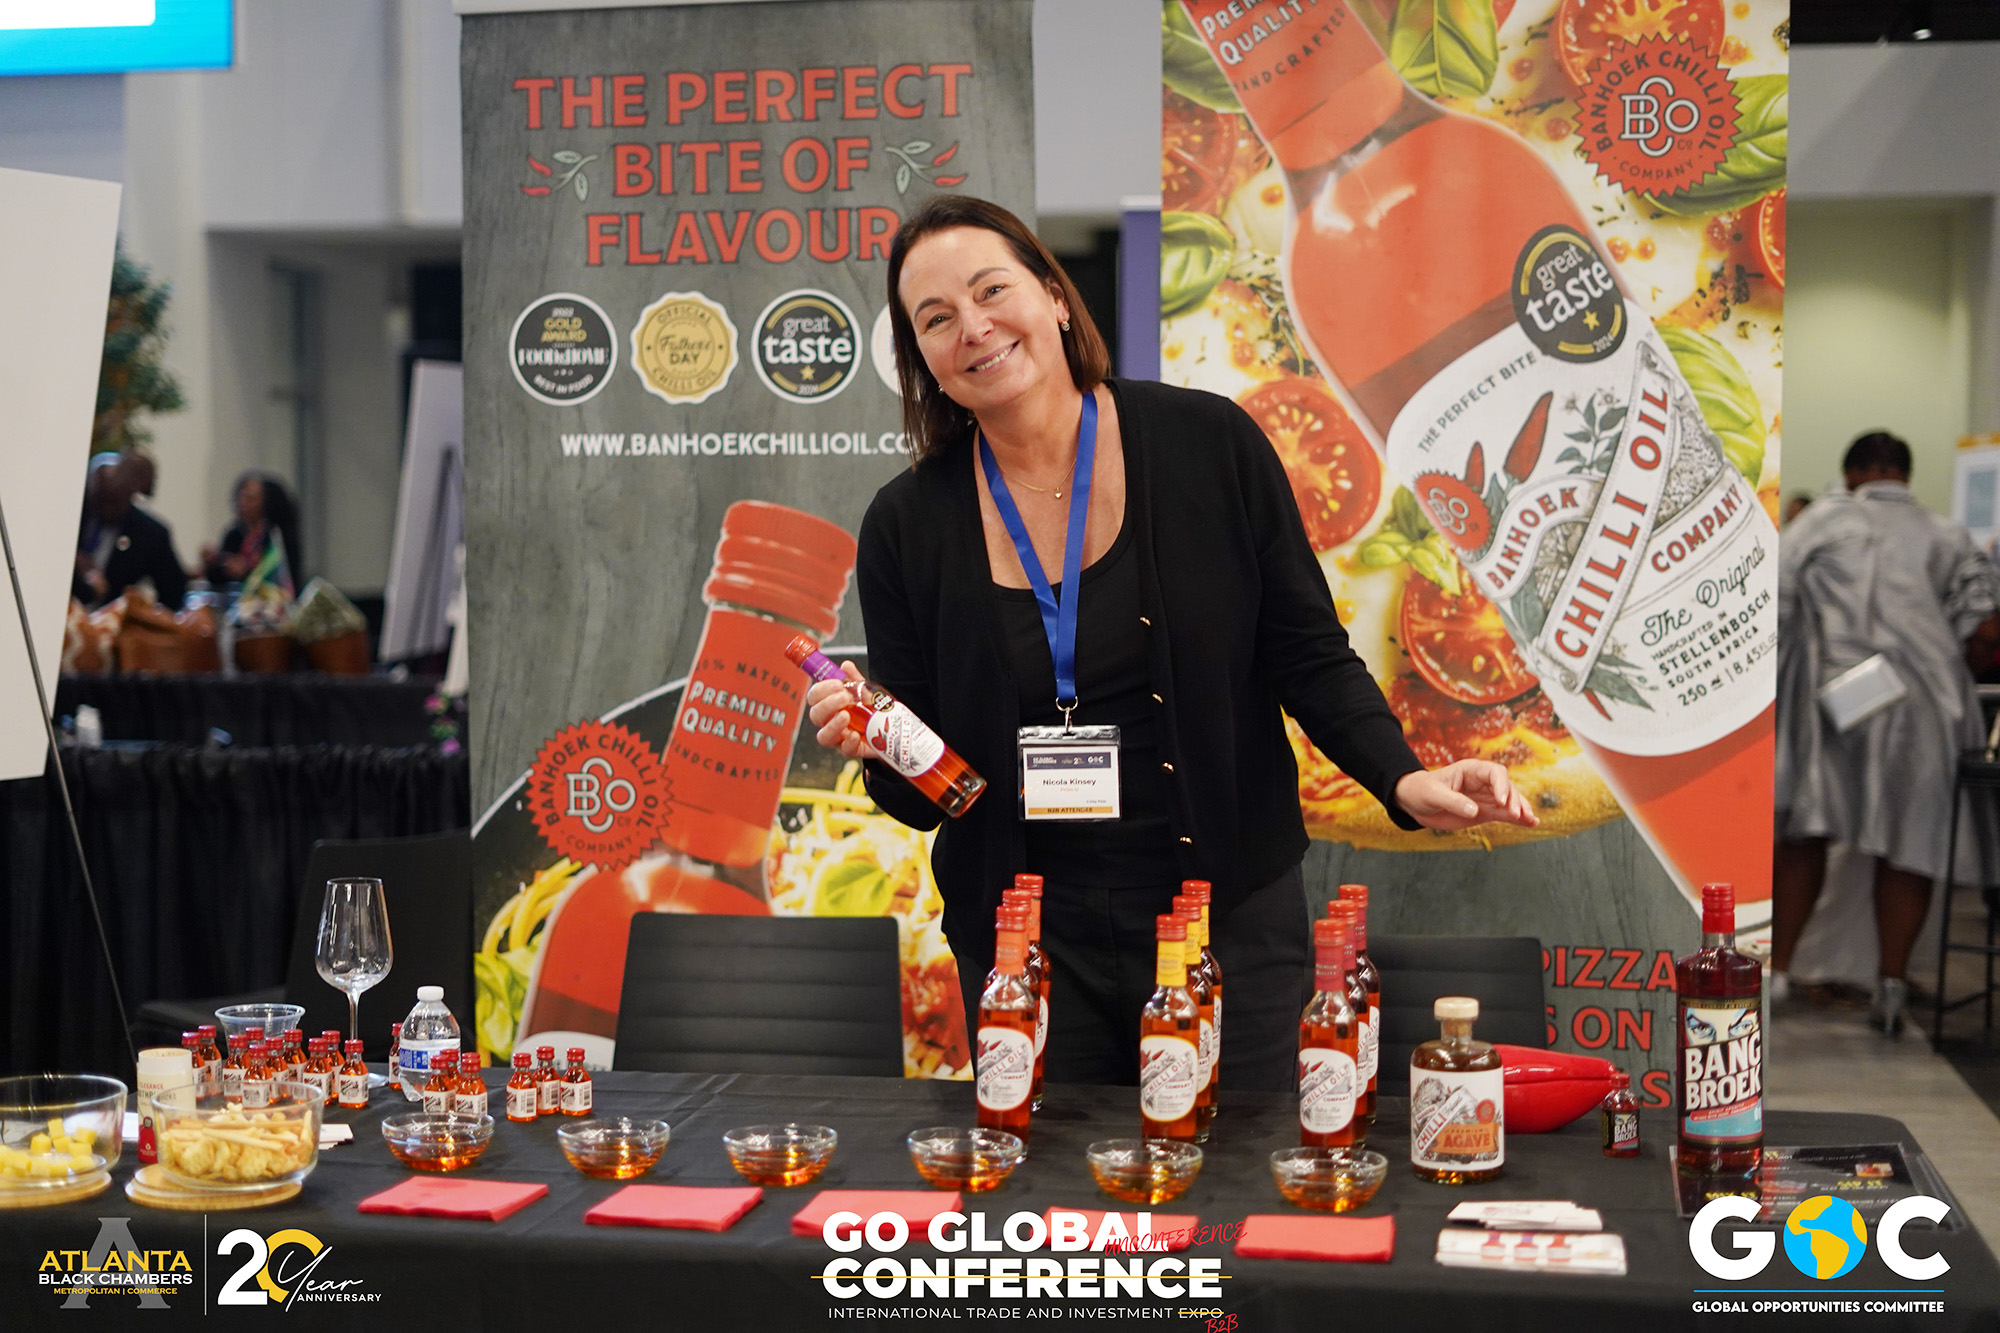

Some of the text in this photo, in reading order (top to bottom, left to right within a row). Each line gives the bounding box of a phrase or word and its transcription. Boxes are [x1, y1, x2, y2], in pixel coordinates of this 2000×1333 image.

[1218, 0, 1317, 65] QUALIT
[1234, 8, 1345, 92] ANDCRAFTED
[513, 63, 973, 130] THE PERFECT
[1591, 51, 1725, 152] BANHOEK CHILLI OIL
[613, 137, 871, 197] BITE OF
[1619, 159, 1694, 180] COMPANY
[586, 206, 899, 266] FLAVOUR
[1536, 243, 1583, 292] great
[1525, 260, 1614, 332] taste
[541, 329, 587, 342] AWARD
[544, 317, 582, 330] GOLD
[783, 315, 831, 338] great
[670, 353, 699, 364] DAY
[763, 334, 852, 364] taste
[1418, 350, 1537, 452] THE PERFECT BITE
[1487, 487, 1578, 590] BANHOEK
[1555, 388, 1668, 658] CHILLI OIL
[1651, 483, 1743, 572] COMPANY
[1641, 535, 1766, 646] The Original
[1651, 620, 1714, 661] HANDCRAFTED
[1659, 589, 1771, 675] STELLENBOSCH
[1667, 625, 1758, 688] SOUTH AFRICA
[688, 680, 786, 728] PREMIUM
[736, 662, 800, 706] NATURA
[1678, 683, 1707, 706] 250
[682, 707, 777, 753] QUALITY
[541, 734, 658, 827] BANHOEK CHILLI OIL
[1043, 778, 1097, 787] Nicola Kinsey
[566, 834, 632, 852] COMPANY
[1572, 1006, 1653, 1051] ON
[1685, 1029, 1762, 1082] BANG
[1685, 1062, 1762, 1111] BROEK
[1417, 1112, 1447, 1150] CHILLI
[1443, 1133, 1491, 1148] AGAVE
[1614, 1120, 1637, 1135] BANG
